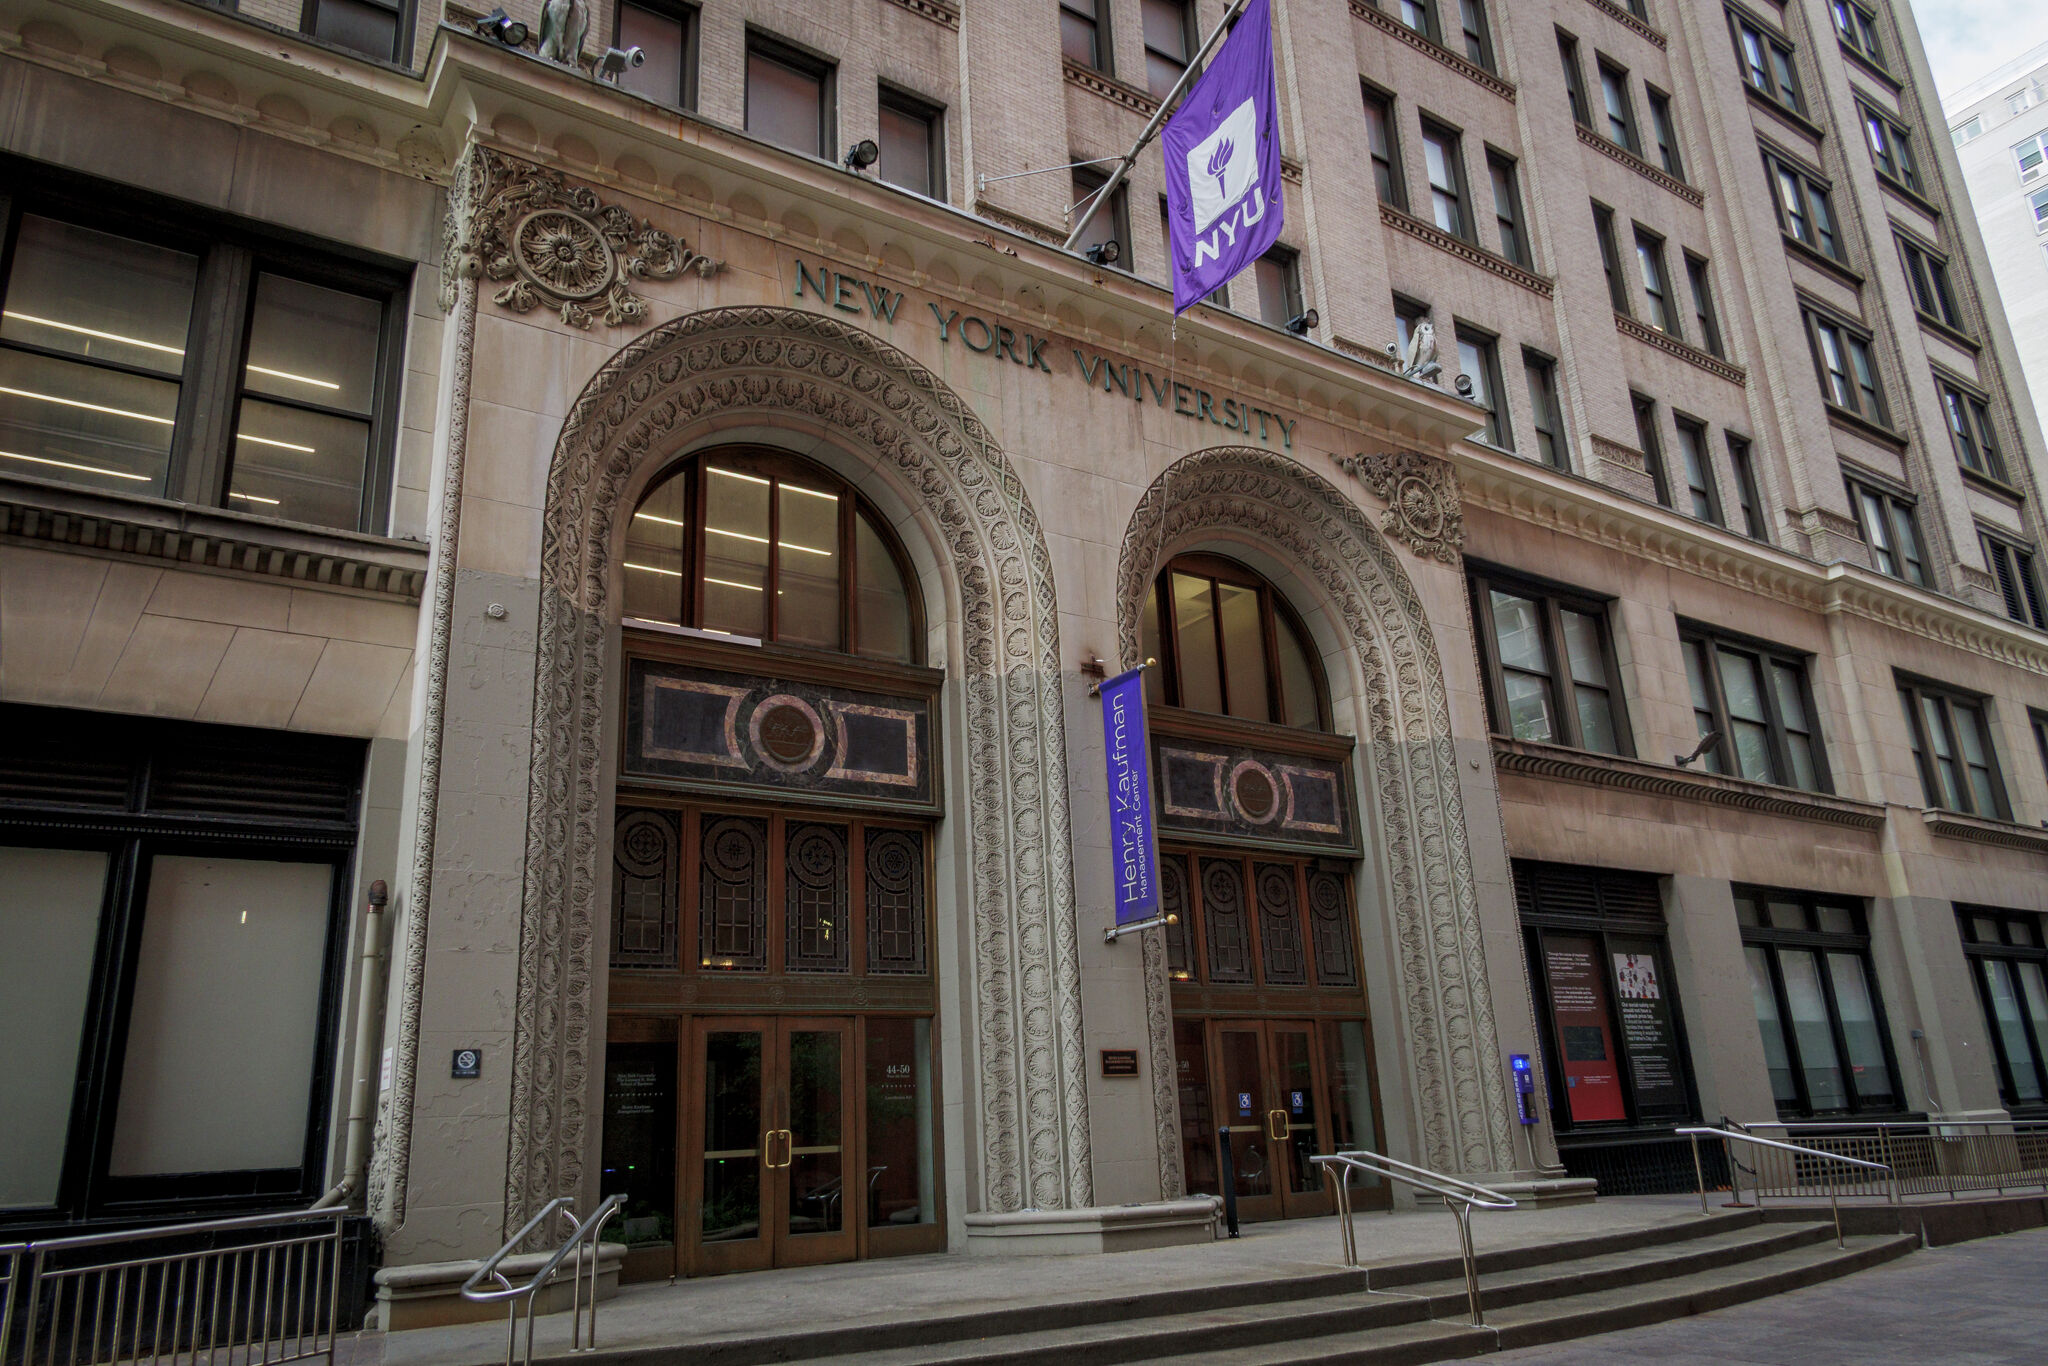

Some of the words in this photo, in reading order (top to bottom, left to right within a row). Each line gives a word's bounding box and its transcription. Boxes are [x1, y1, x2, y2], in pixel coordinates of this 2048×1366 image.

[1194, 186, 1265, 268] NYU
[794, 259, 904, 324] NEW
[928, 302, 1051, 374] YORK
[1112, 692, 1131, 813] Kaufman
[1132, 769, 1141, 811] Center
[1121, 820, 1138, 903] Henry
[1135, 815, 1147, 898] Management
[886, 1064, 911, 1074] 44-50
